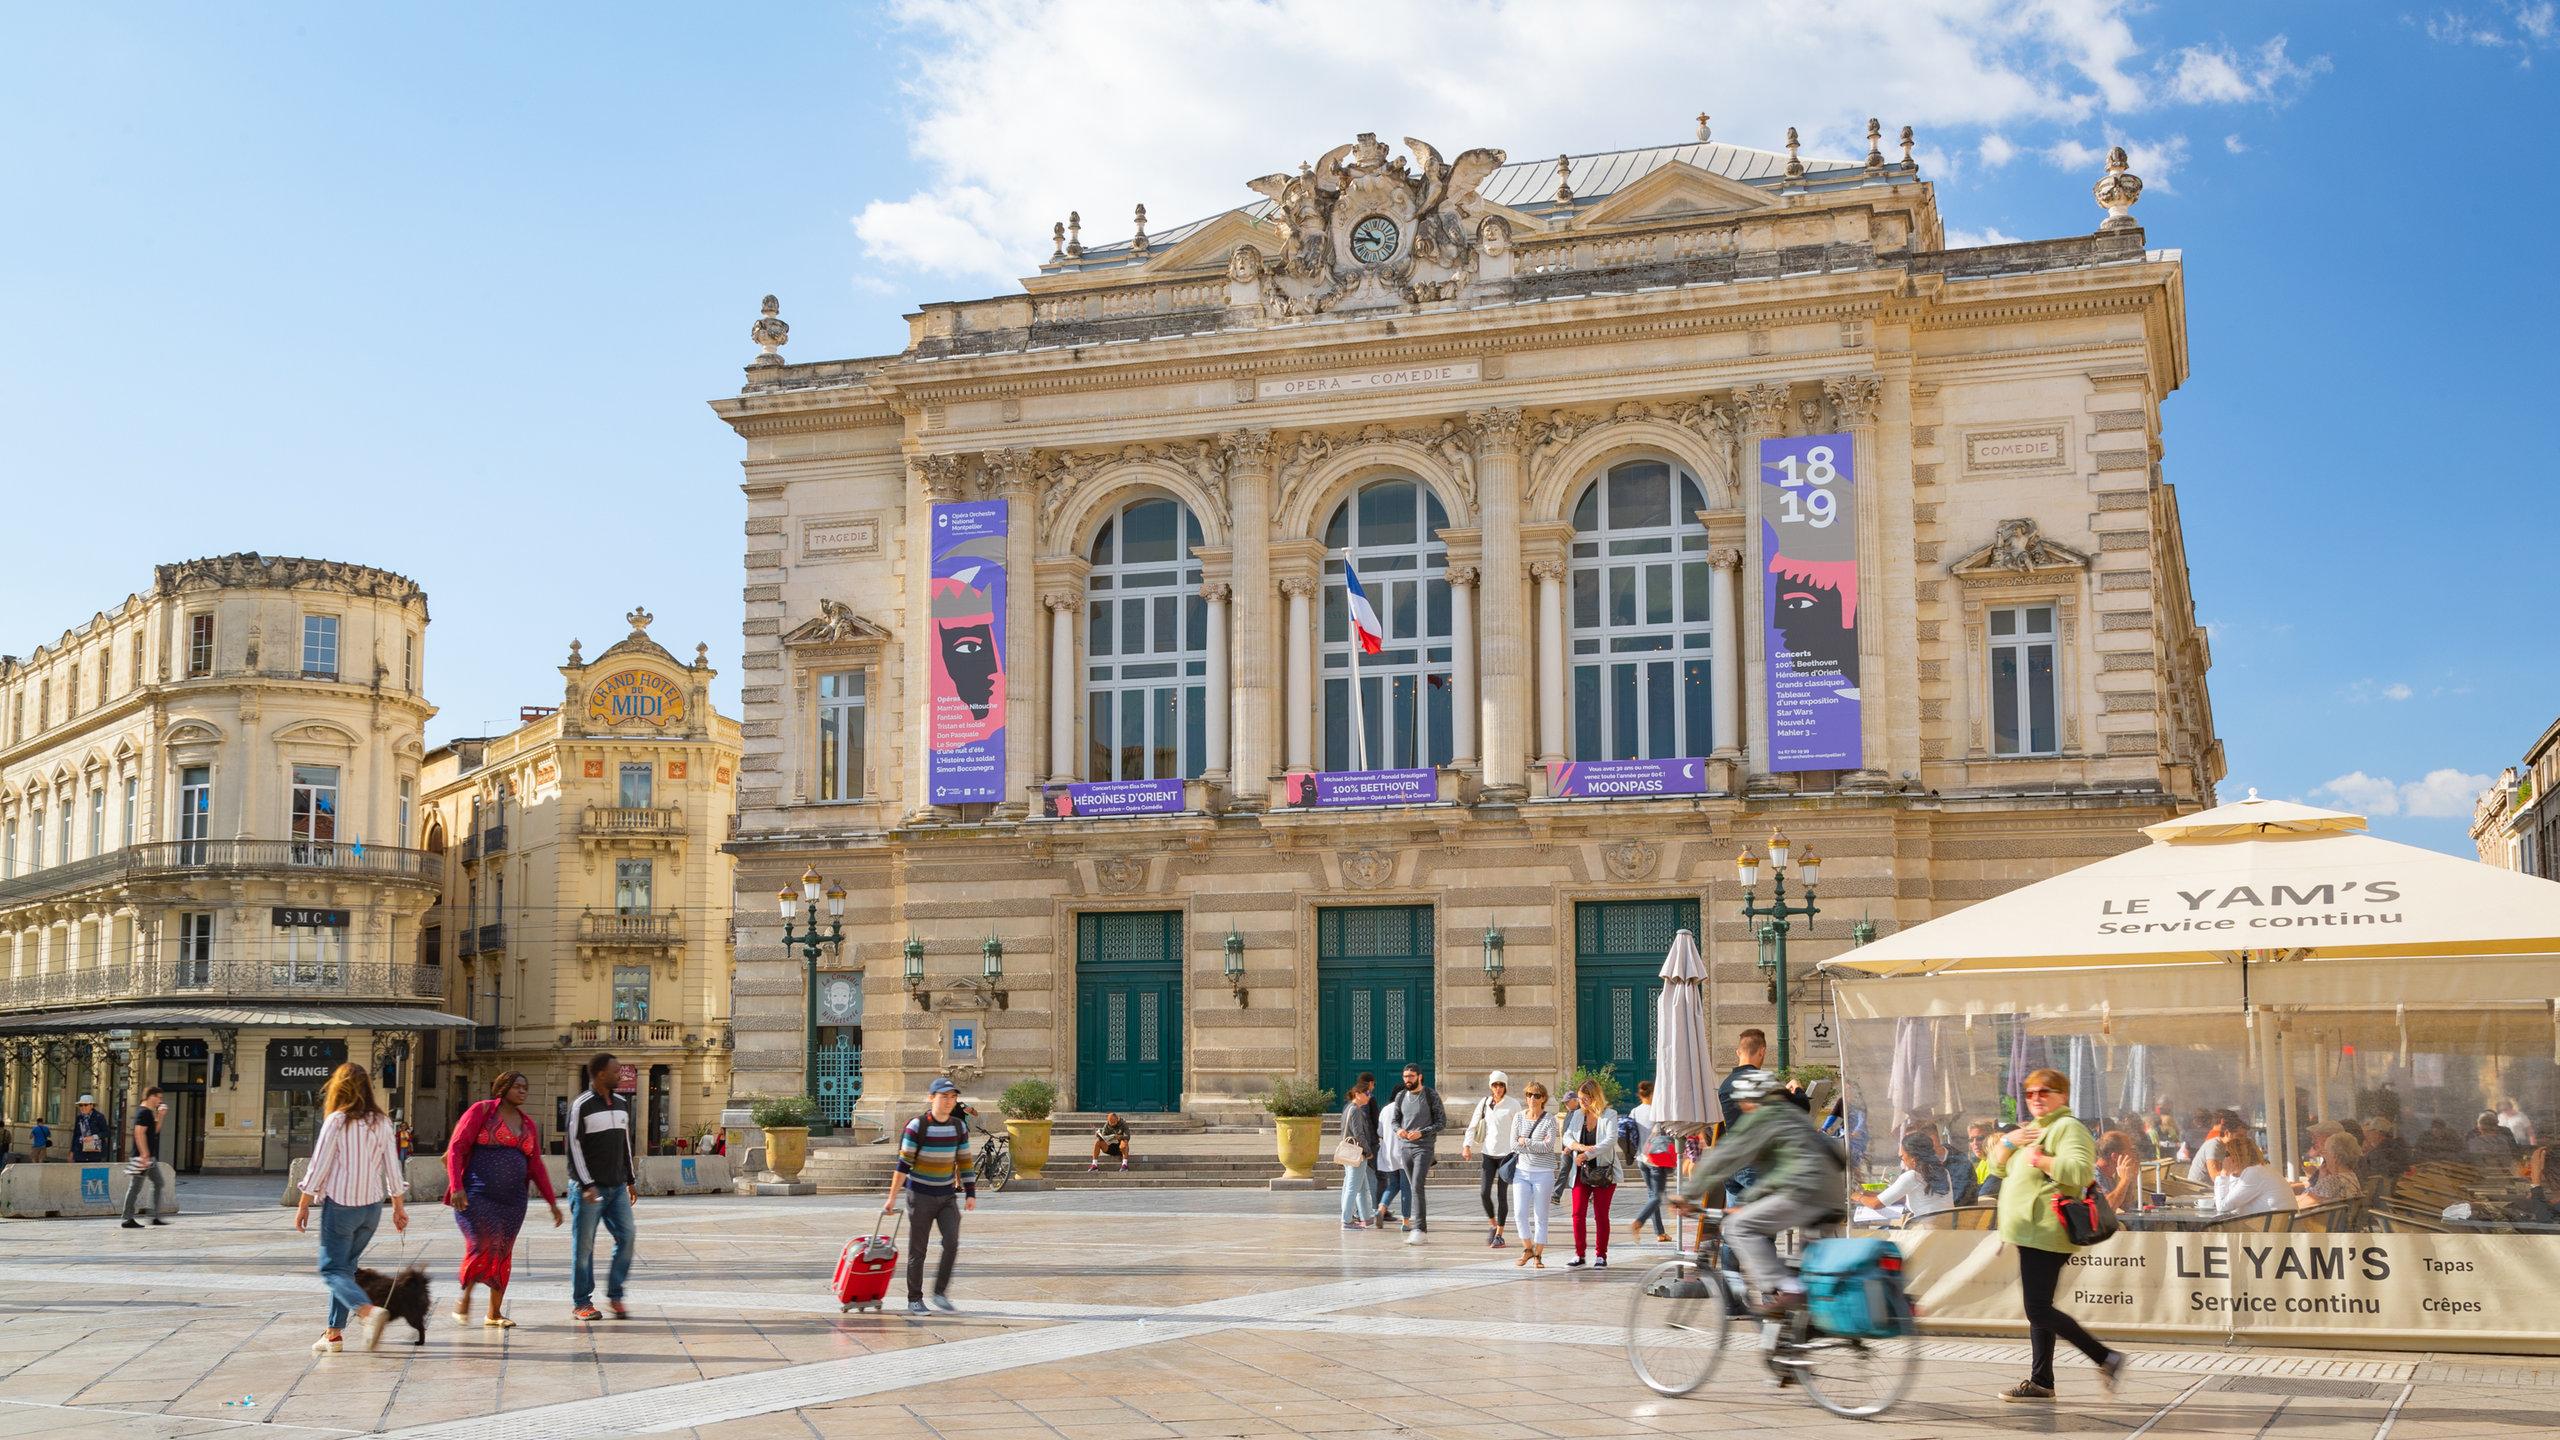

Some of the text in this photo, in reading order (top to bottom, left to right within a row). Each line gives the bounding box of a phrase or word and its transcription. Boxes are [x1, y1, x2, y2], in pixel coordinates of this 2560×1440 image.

[1285, 378, 1341, 393] OPERA
[1371, 367, 1452, 385] COMEDIE
[1981, 442, 2049, 457] COMEDIE
[1778, 445, 1836, 487] 18
[1780, 488, 1837, 528] 19
[951, 517, 975, 525] National
[814, 531, 868, 544] TRAGEDIE
[1775, 650, 1812, 659] Concerts
[1775, 659, 1839, 669] 100% Beethoven
[1810, 668, 1842, 677] d'Orient
[1776, 679, 1845, 689] Grands classiques
[592, 673, 680, 707] GRAND HOTEL
[631, 686, 644, 694] DU
[1776, 690, 1811, 699] Tableaux
[612, 694, 663, 716] MIDI
[1776, 696, 1839, 707] d'une exposition
[1776, 708, 1814, 717] Star Wars
[958, 721, 966, 729] et
[1777, 718, 1816, 727] Nouvel An
[950, 731, 980, 739] Pasquale
[1777, 729, 1804, 737] Mahler
[945, 741, 966, 749] Songe
[957, 765, 995, 773] Boccanegra
[1323, 775, 1344, 783] Michael
[1112, 783, 1129, 792] lyrique
[1332, 781, 1419, 794] 100% BEETHOVEN
[1588, 779, 1663, 793] MOONPASS
[1073, 790, 1178, 806] HÉROÏNES D'ORIENT
[1339, 795, 1366, 803] septembre
[1141, 803, 1163, 811] Comédie
[2101, 880, 2401, 915] LE YAM'S
[2097, 911, 2403, 935] Service continu
[957, 1034, 970, 1047] M
[281, 1066, 329, 1077] CHANGE
[2175, 1245, 2230, 1280] LE
[2242, 1245, 2391, 1281] YAM'S
[2422, 1257, 2474, 1276] Tapas
[2074, 1290, 2482, 1315] Pizzeria Service continu Crêpes
